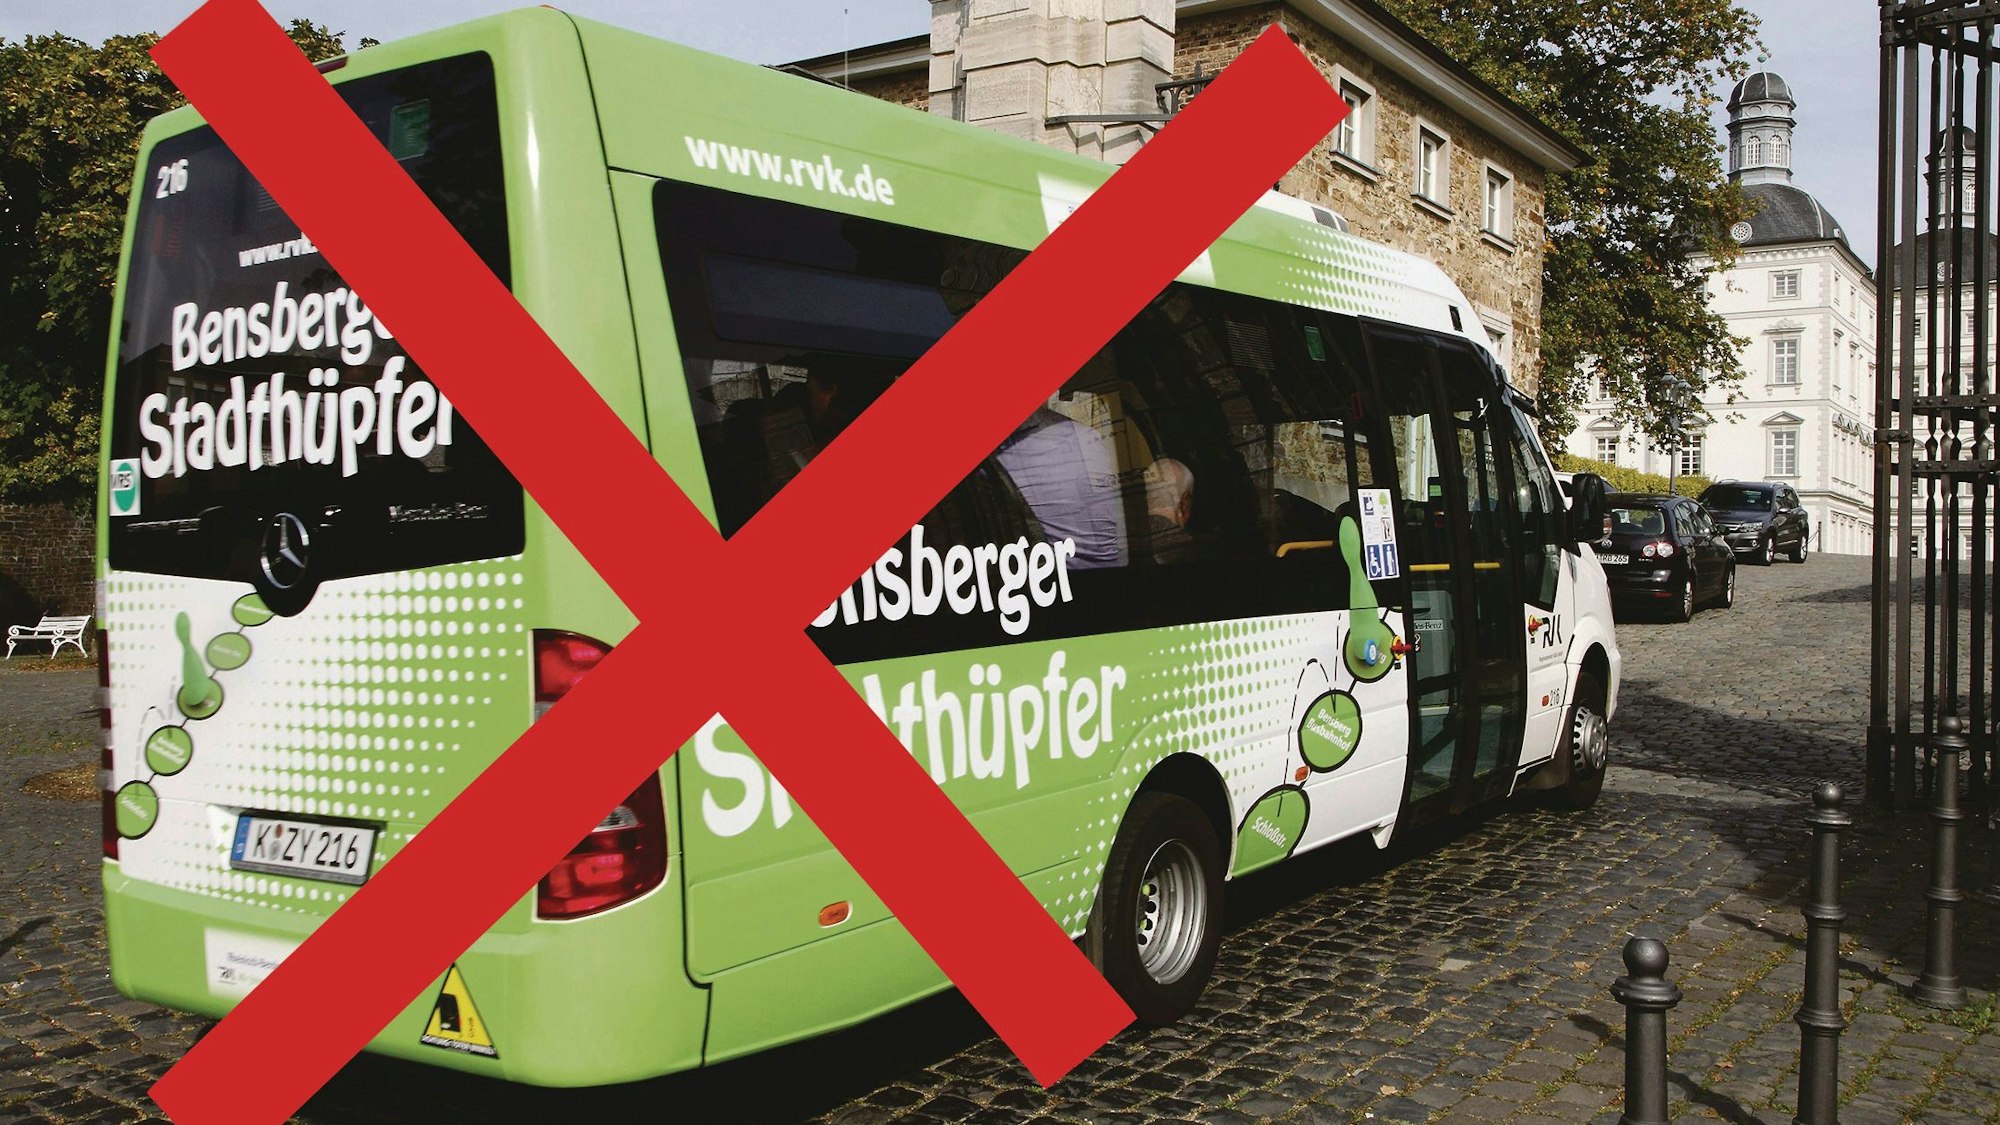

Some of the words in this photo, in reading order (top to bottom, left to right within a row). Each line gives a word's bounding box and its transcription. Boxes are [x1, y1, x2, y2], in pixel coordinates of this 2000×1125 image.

[156, 158, 189, 199] 216
[684, 136, 895, 205] www.rvk.de
[239, 231, 319, 267] www.rvk.
[173, 281, 394, 371] Bensberg
[811, 523, 1076, 635] nsberger
[693, 650, 1127, 838] Sthüpfer
[1306, 718, 1352, 752] Busbahnhof
[1318, 708, 1352, 738] Bensberg
[252, 823, 271, 858] K
[282, 827, 315, 863] ZY
[316, 831, 358, 868] 216
[1251, 816, 1287, 848] Schloßstr.
